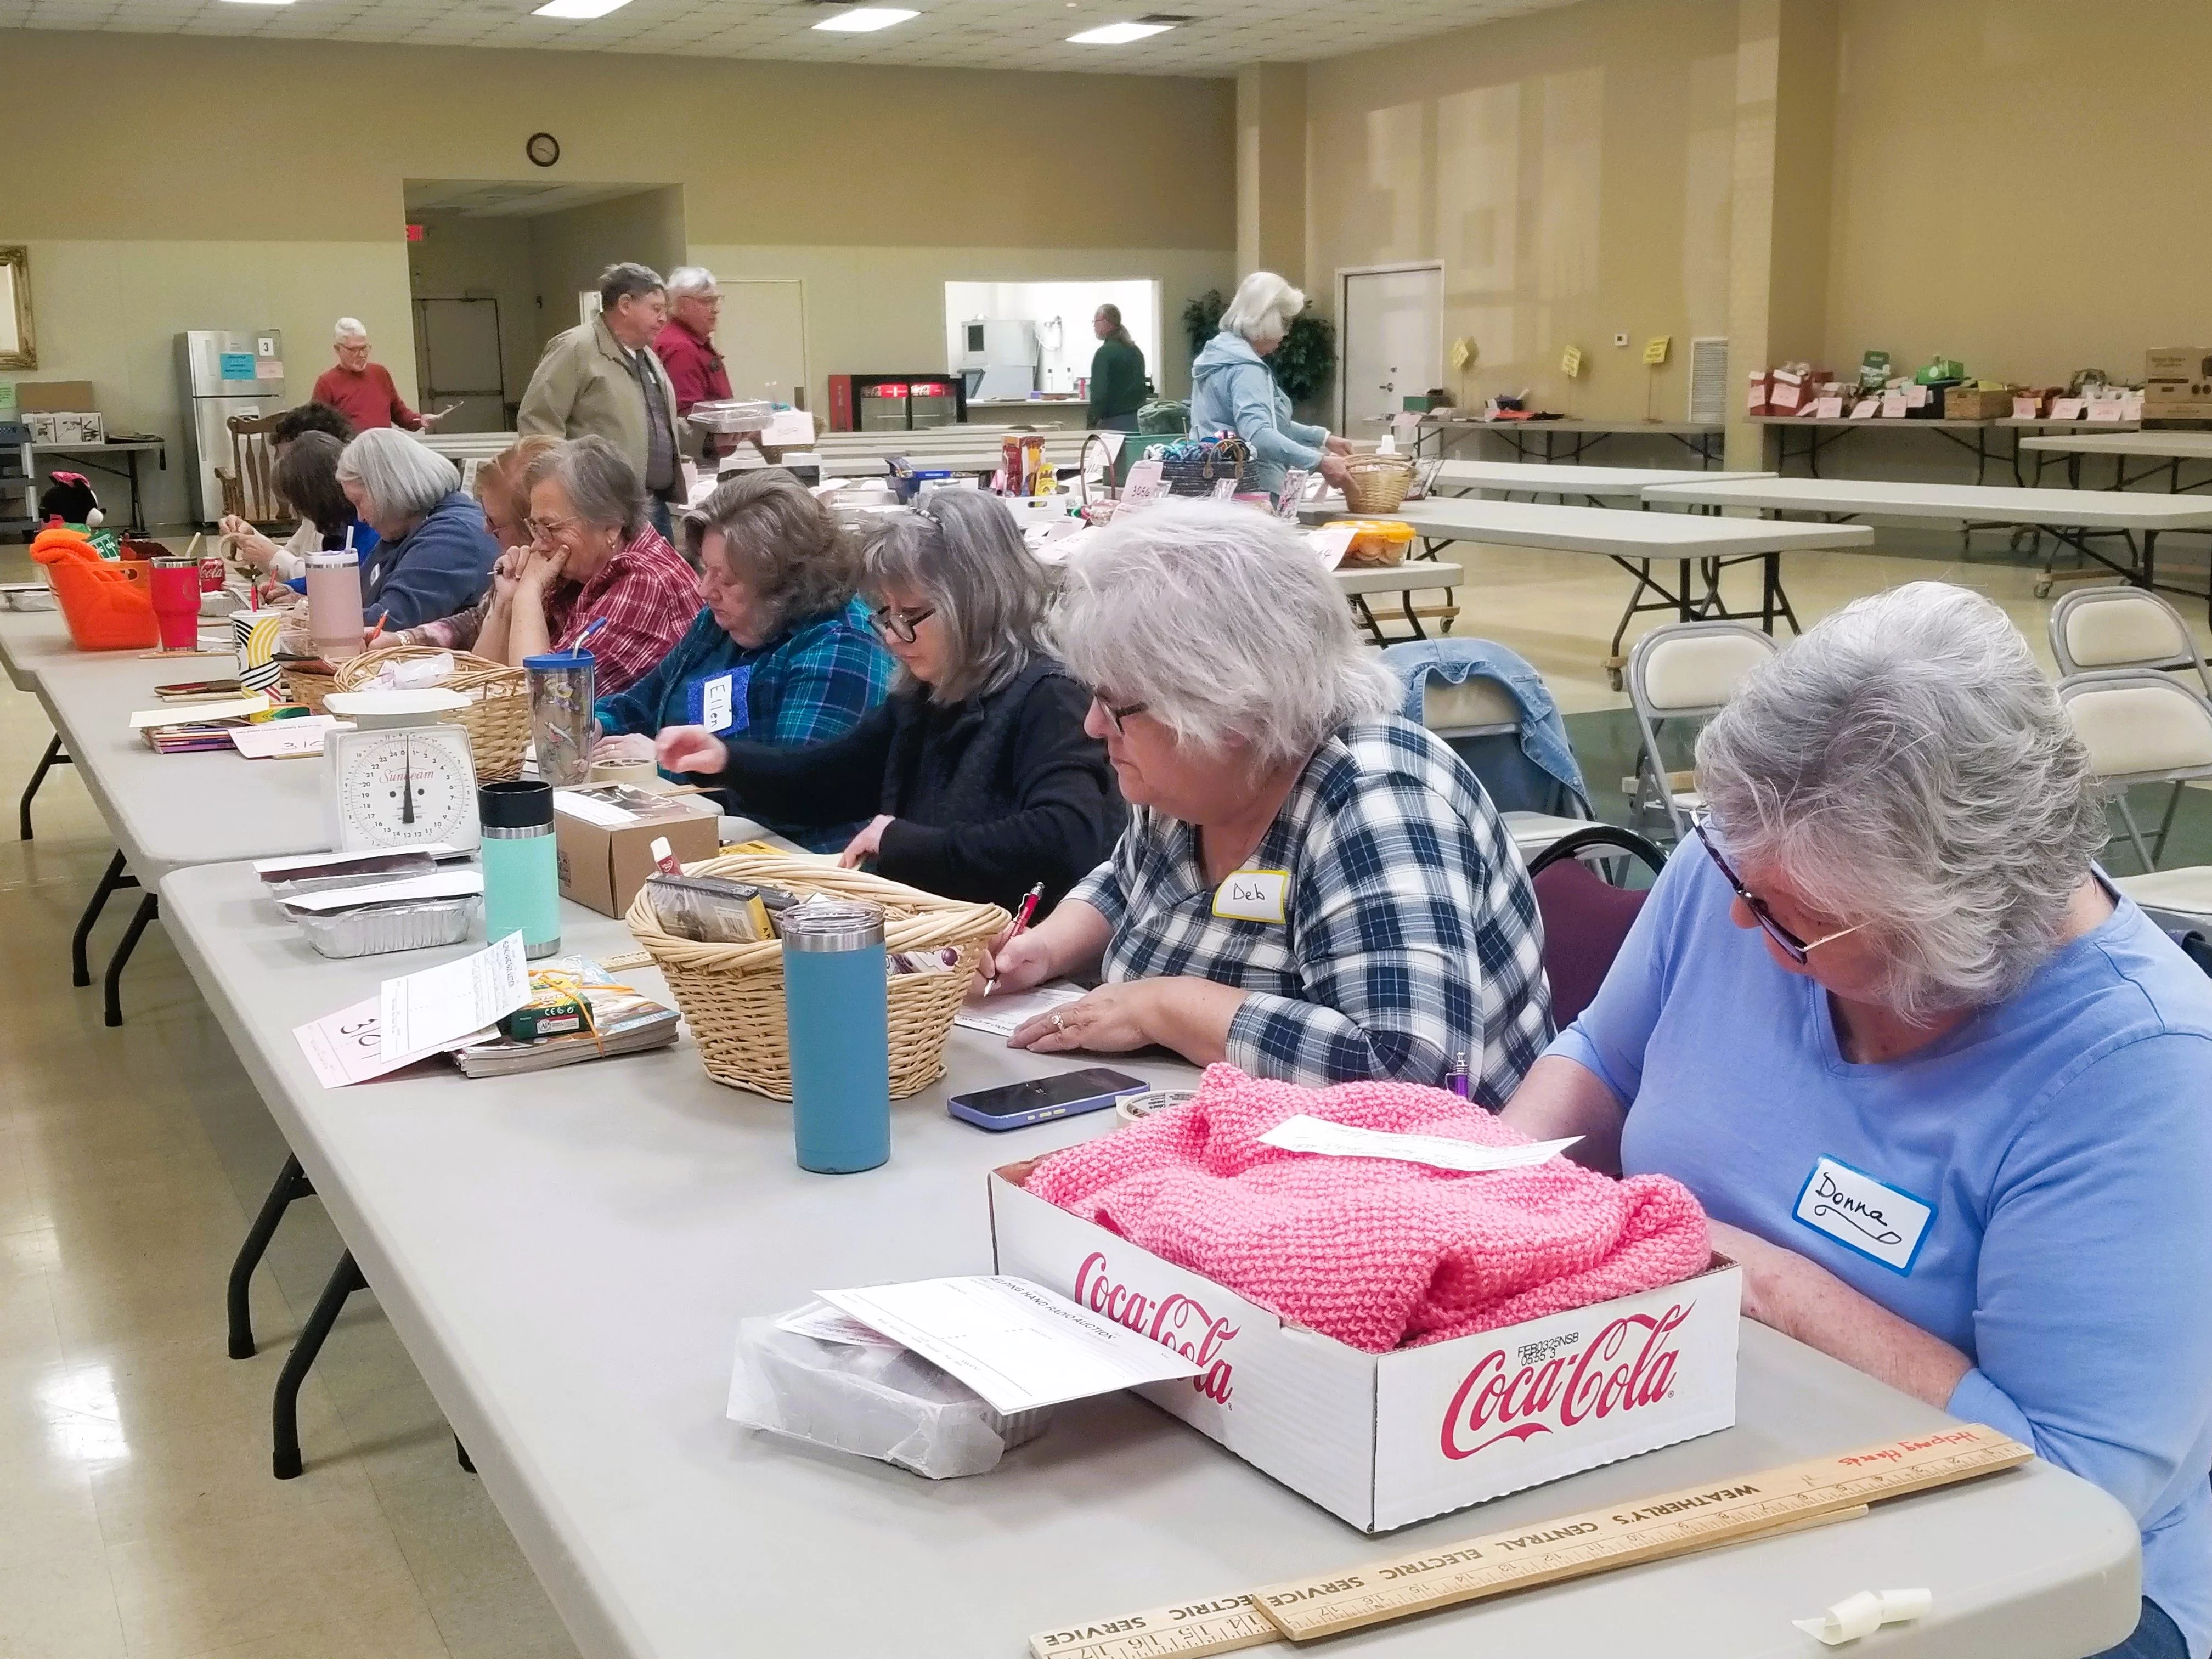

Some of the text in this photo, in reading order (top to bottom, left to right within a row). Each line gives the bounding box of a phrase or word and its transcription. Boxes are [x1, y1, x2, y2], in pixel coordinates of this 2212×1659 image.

[263, 342, 269, 352] 3
[379, 769, 434, 784] Suneam
[1233, 883, 1265, 901] Deb
[1815, 1172, 1888, 1227] Donna
[989, 1277, 1025, 1293] HELPING
[1020, 1290, 1048, 1307] HAND
[1045, 1305, 1076, 1319] RADIO
[1072, 1318, 1117, 1340] AUCTION
[1440, 1298, 1697, 1460] Coca-Cola
[1267, 1484, 1762, 1607] WEATHERLY'S CENTRAL ELECTRIC SERVICE
[1543, 1553, 1562, 1562] 12
[1498, 1564, 1517, 1572] 13
[1454, 1574, 1475, 1583] 14
[1409, 1584, 1431, 1594] 15
[1321, 1605, 1339, 1617] 17
[1043, 1593, 1255, 1646] ECTRIC SERVICE
[1226, 1614, 1262, 1630] 14
[1177, 1624, 1211, 1640] 15
[1127, 1634, 1163, 1650] 16
